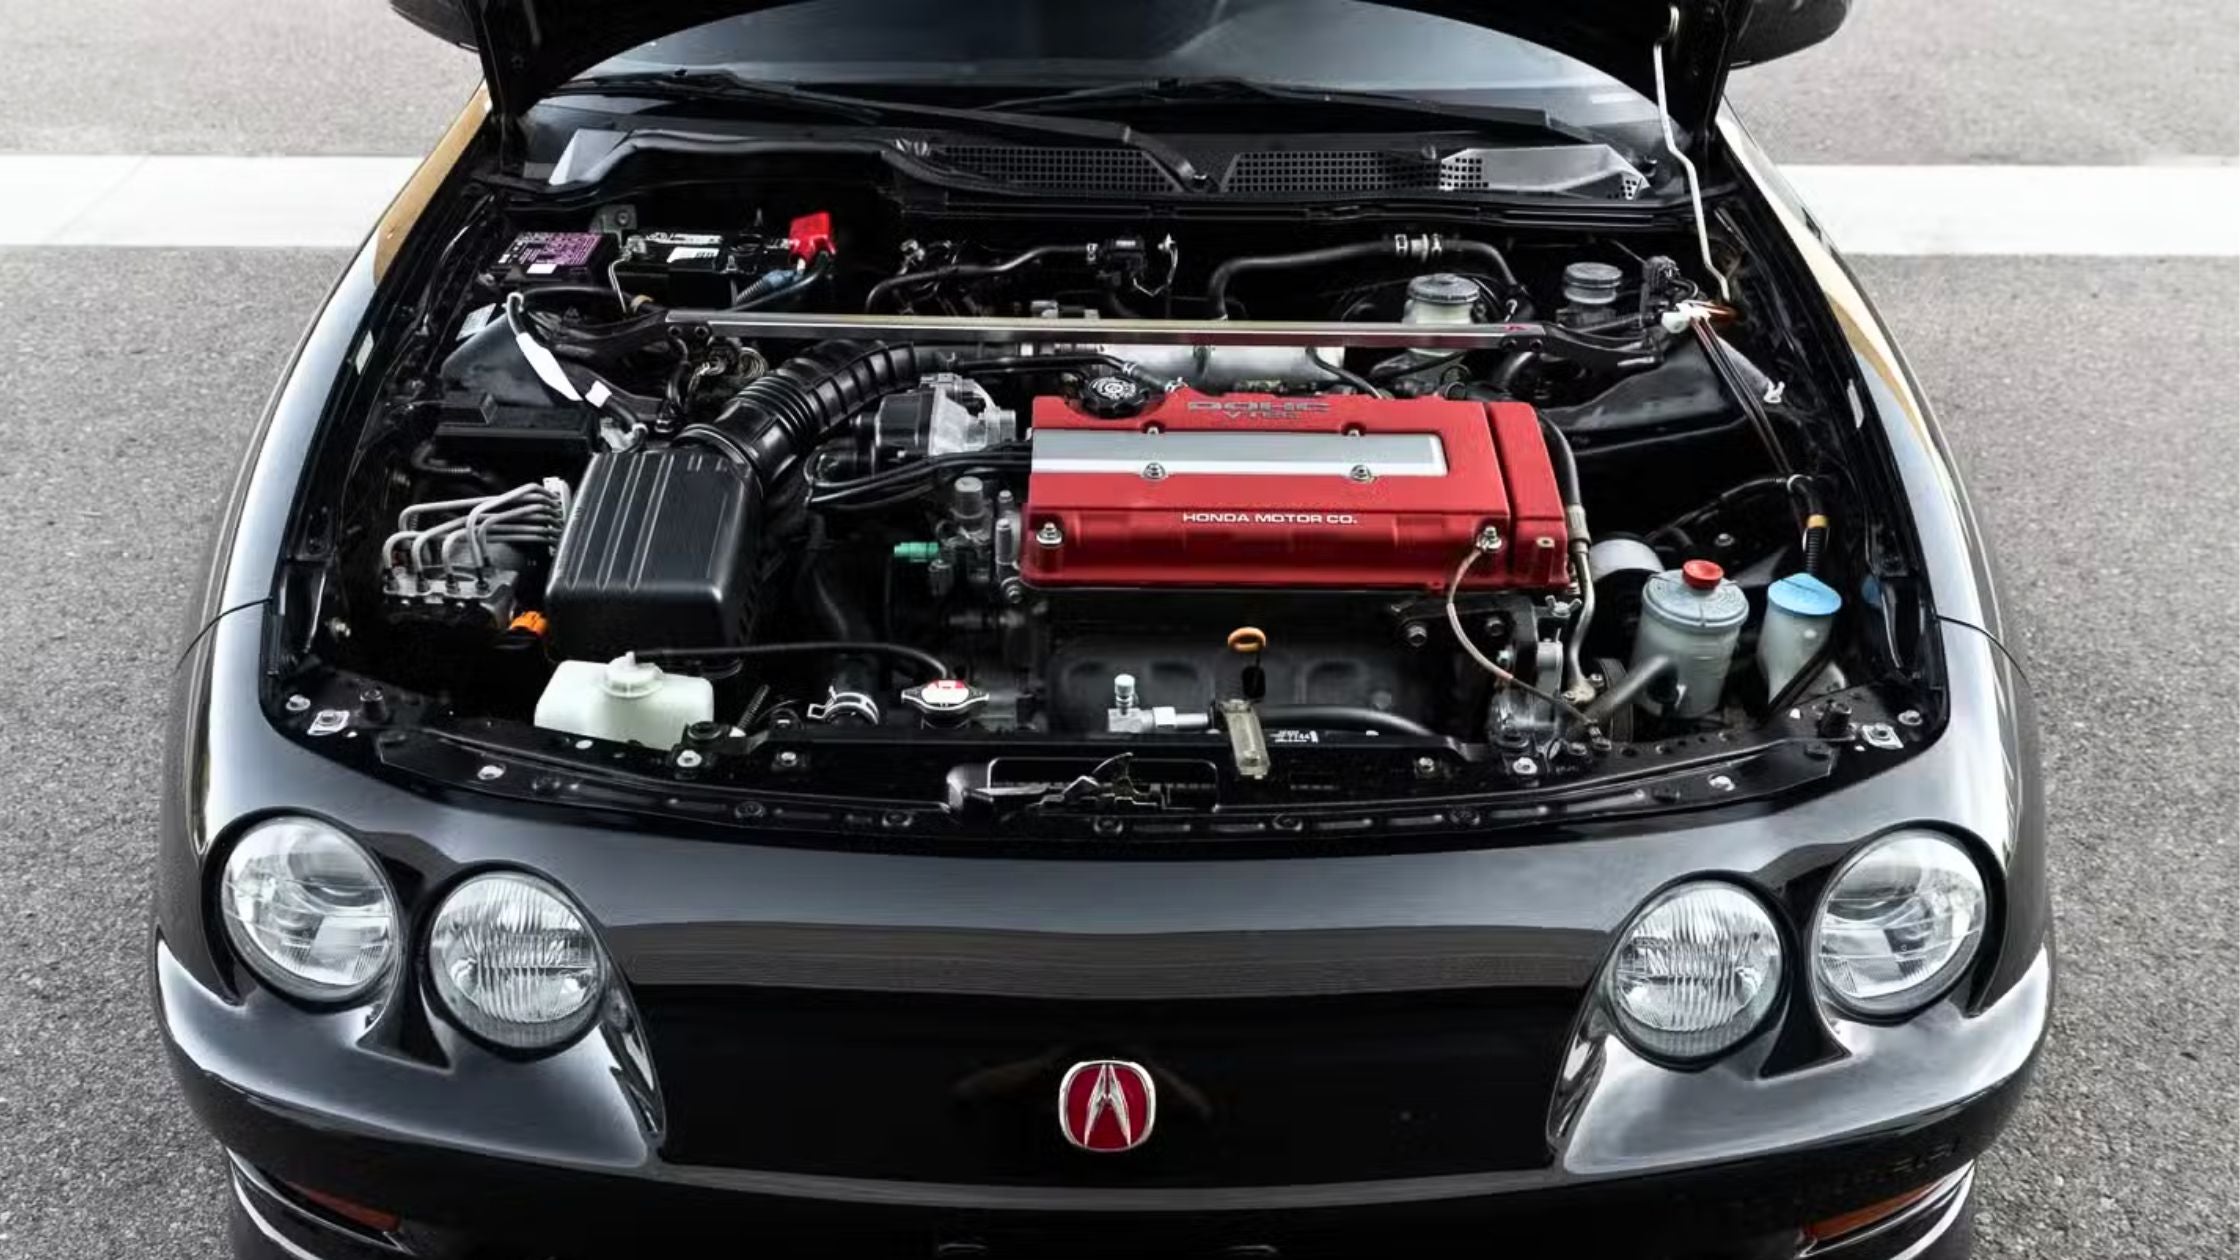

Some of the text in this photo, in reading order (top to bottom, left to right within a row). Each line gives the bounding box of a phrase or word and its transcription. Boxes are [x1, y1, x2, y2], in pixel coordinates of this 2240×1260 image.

[1187, 401, 1330, 412] DOHC
[1182, 512, 1358, 525] HONDA MOTOR CO.
